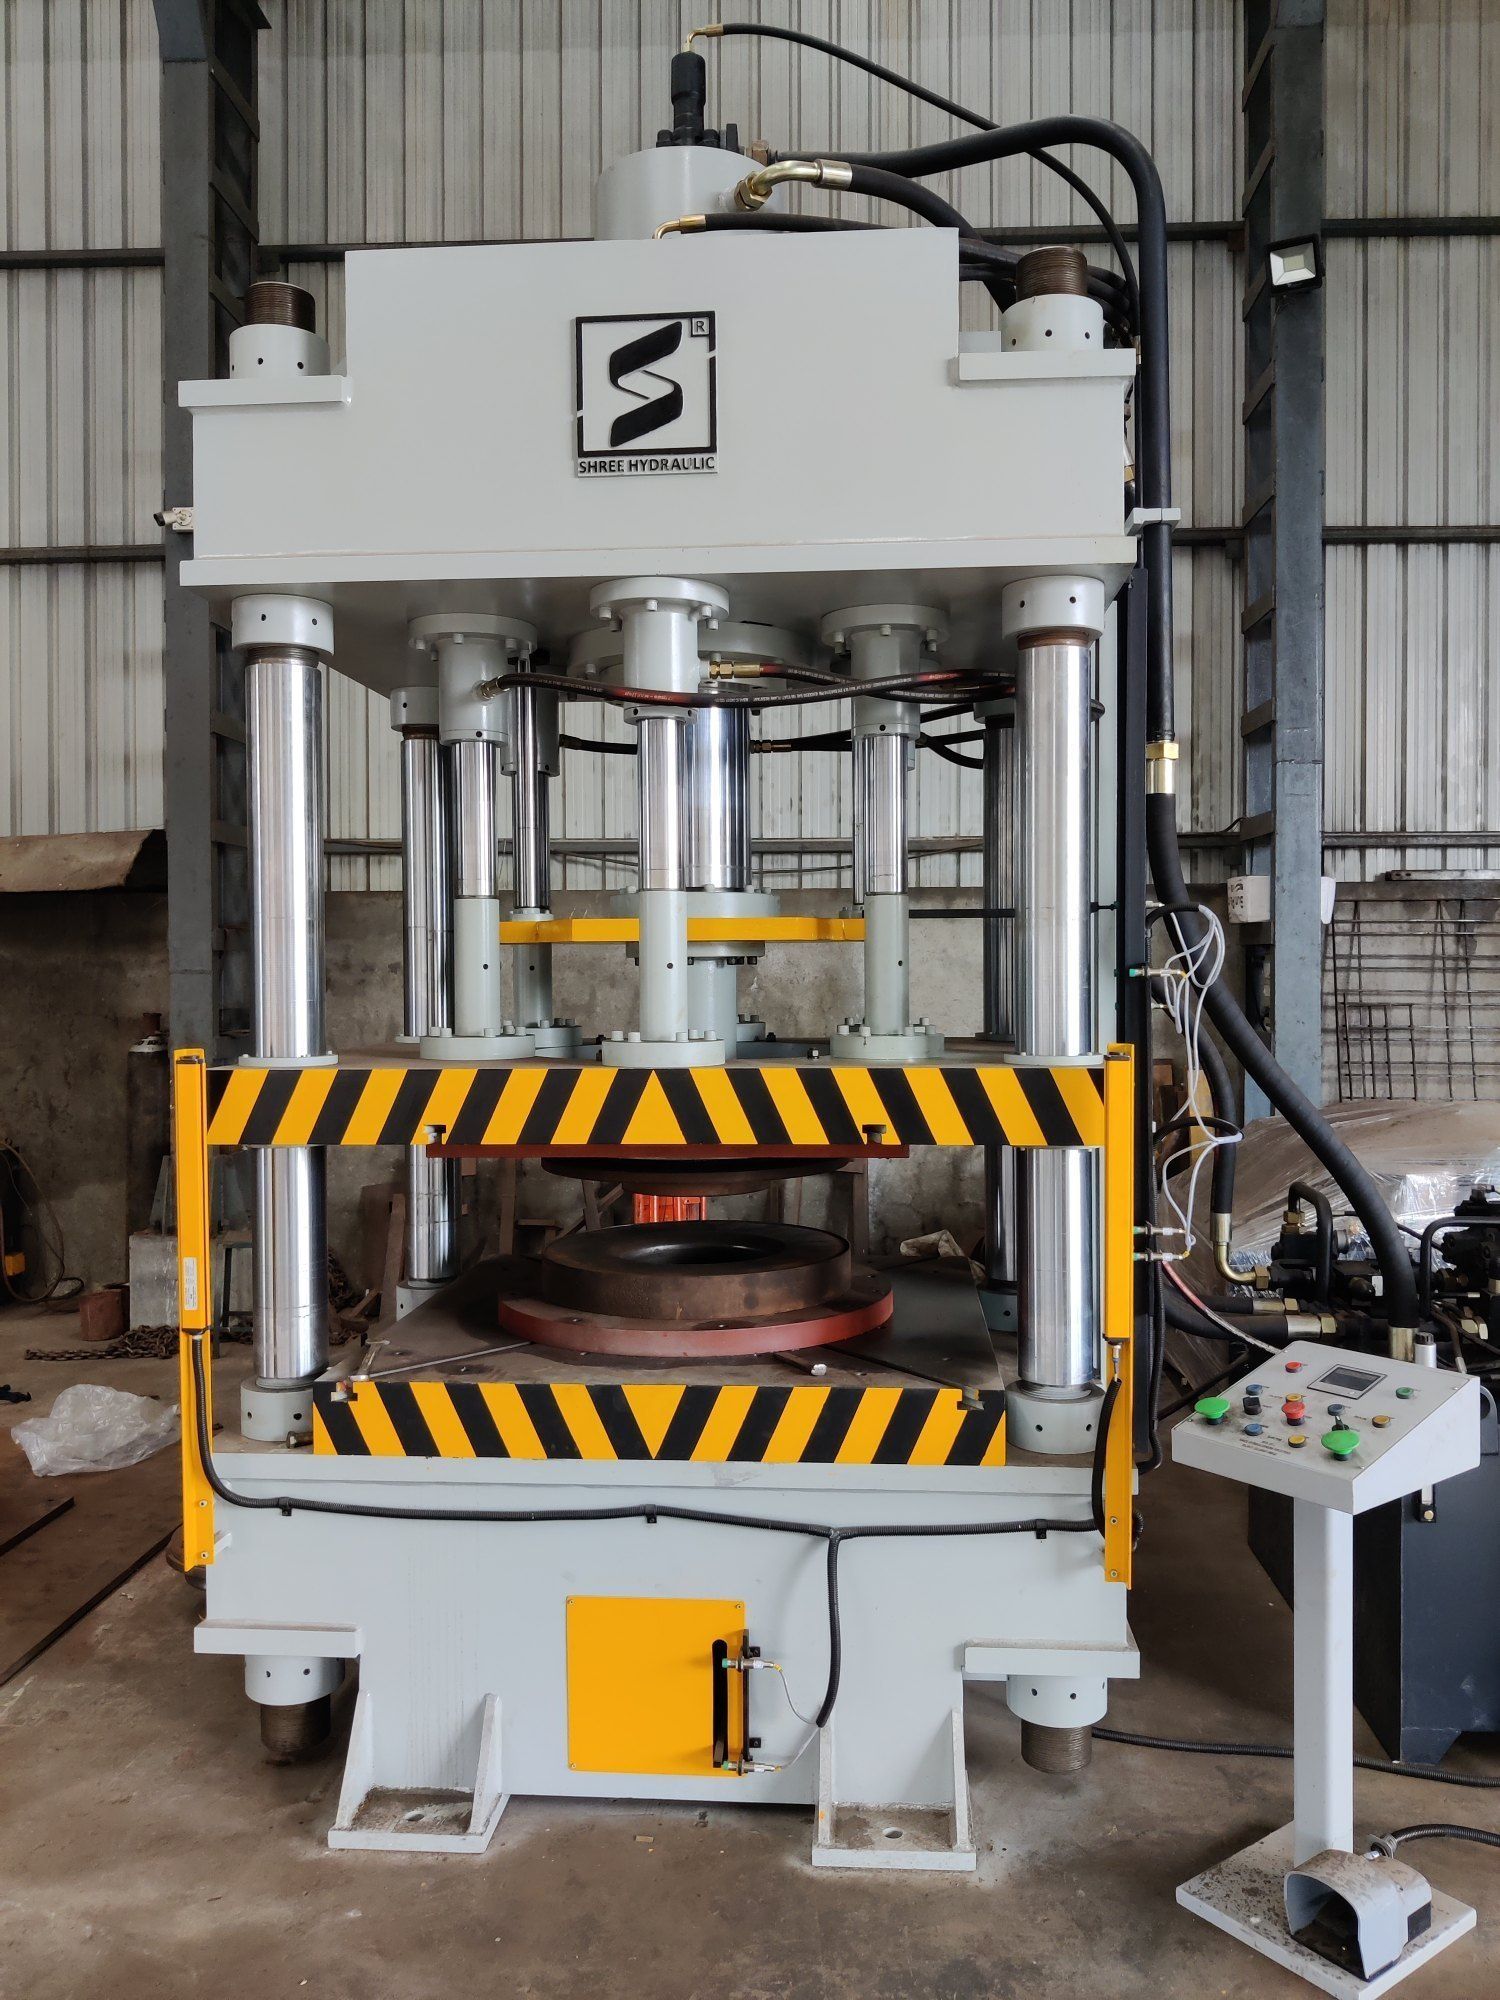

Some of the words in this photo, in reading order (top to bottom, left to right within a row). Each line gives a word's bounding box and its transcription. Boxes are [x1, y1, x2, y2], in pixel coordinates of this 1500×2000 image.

[696, 320, 704, 332] R
[579, 460, 624, 473] SHREE
[629, 457, 714, 471] HYDRAULIC
